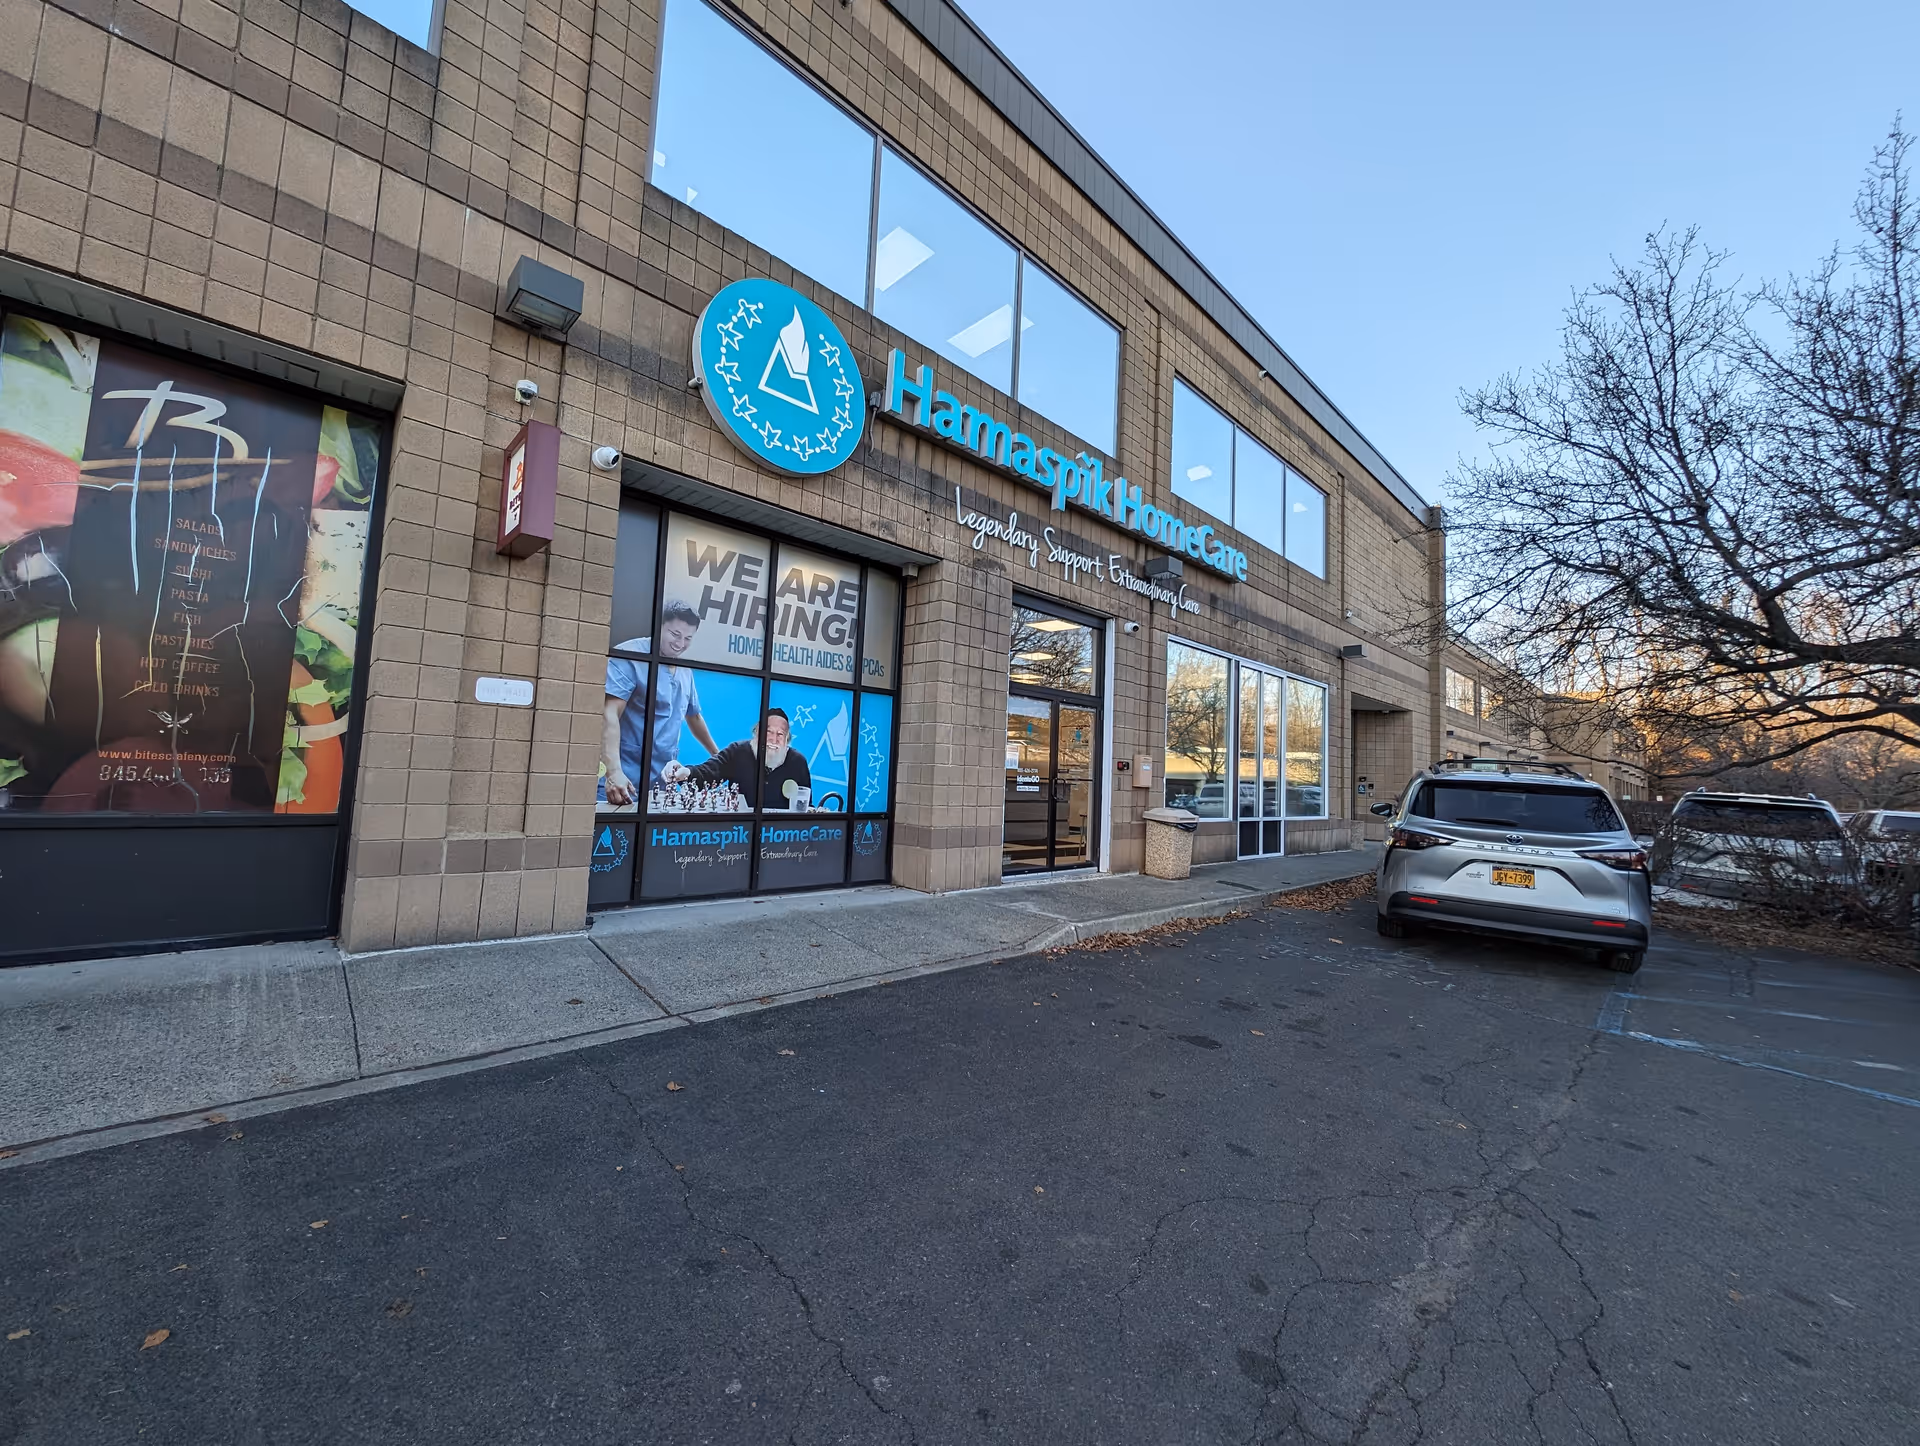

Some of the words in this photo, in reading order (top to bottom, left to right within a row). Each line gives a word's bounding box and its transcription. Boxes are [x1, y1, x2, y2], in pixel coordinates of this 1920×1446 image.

[885, 348, 1114, 516] Hamaspik
[1114, 477, 1248, 582] HomeCare
[175, 518, 221, 535] SALADS
[154, 538, 236, 560] SANDWICHES
[955, 486, 1040, 568] Legendary
[1044, 527, 1104, 583] Support,
[1108, 555, 1178, 618] Extraordinary
[1178, 584, 1200, 616] Care
[175, 565, 211, 580] SUSHI
[686, 539, 763, 591] WE
[776, 568, 859, 613] ARE
[171, 588, 209, 603] PASTA
[173, 612, 201, 625] FISH
[699, 585, 858, 649] HIRING!
[154, 634, 215, 649] PASTRIES
[729, 634, 763, 657] HOME
[773, 642, 814, 666] HEALTH
[815, 649, 843, 671] AIDES
[845, 656, 854, 673] &
[862, 657, 885, 677] PCAs
[140, 657, 167, 668] HOT
[172, 661, 220, 673] COFFEE
[135, 680, 168, 693] COLD
[173, 684, 220, 697] DRINKS
[651, 826, 749, 849] Hamaspik
[761, 826, 842, 843] HomeCare
[1477, 844, 1554, 855] SIENNA
[674, 850, 713, 869] Legendary
